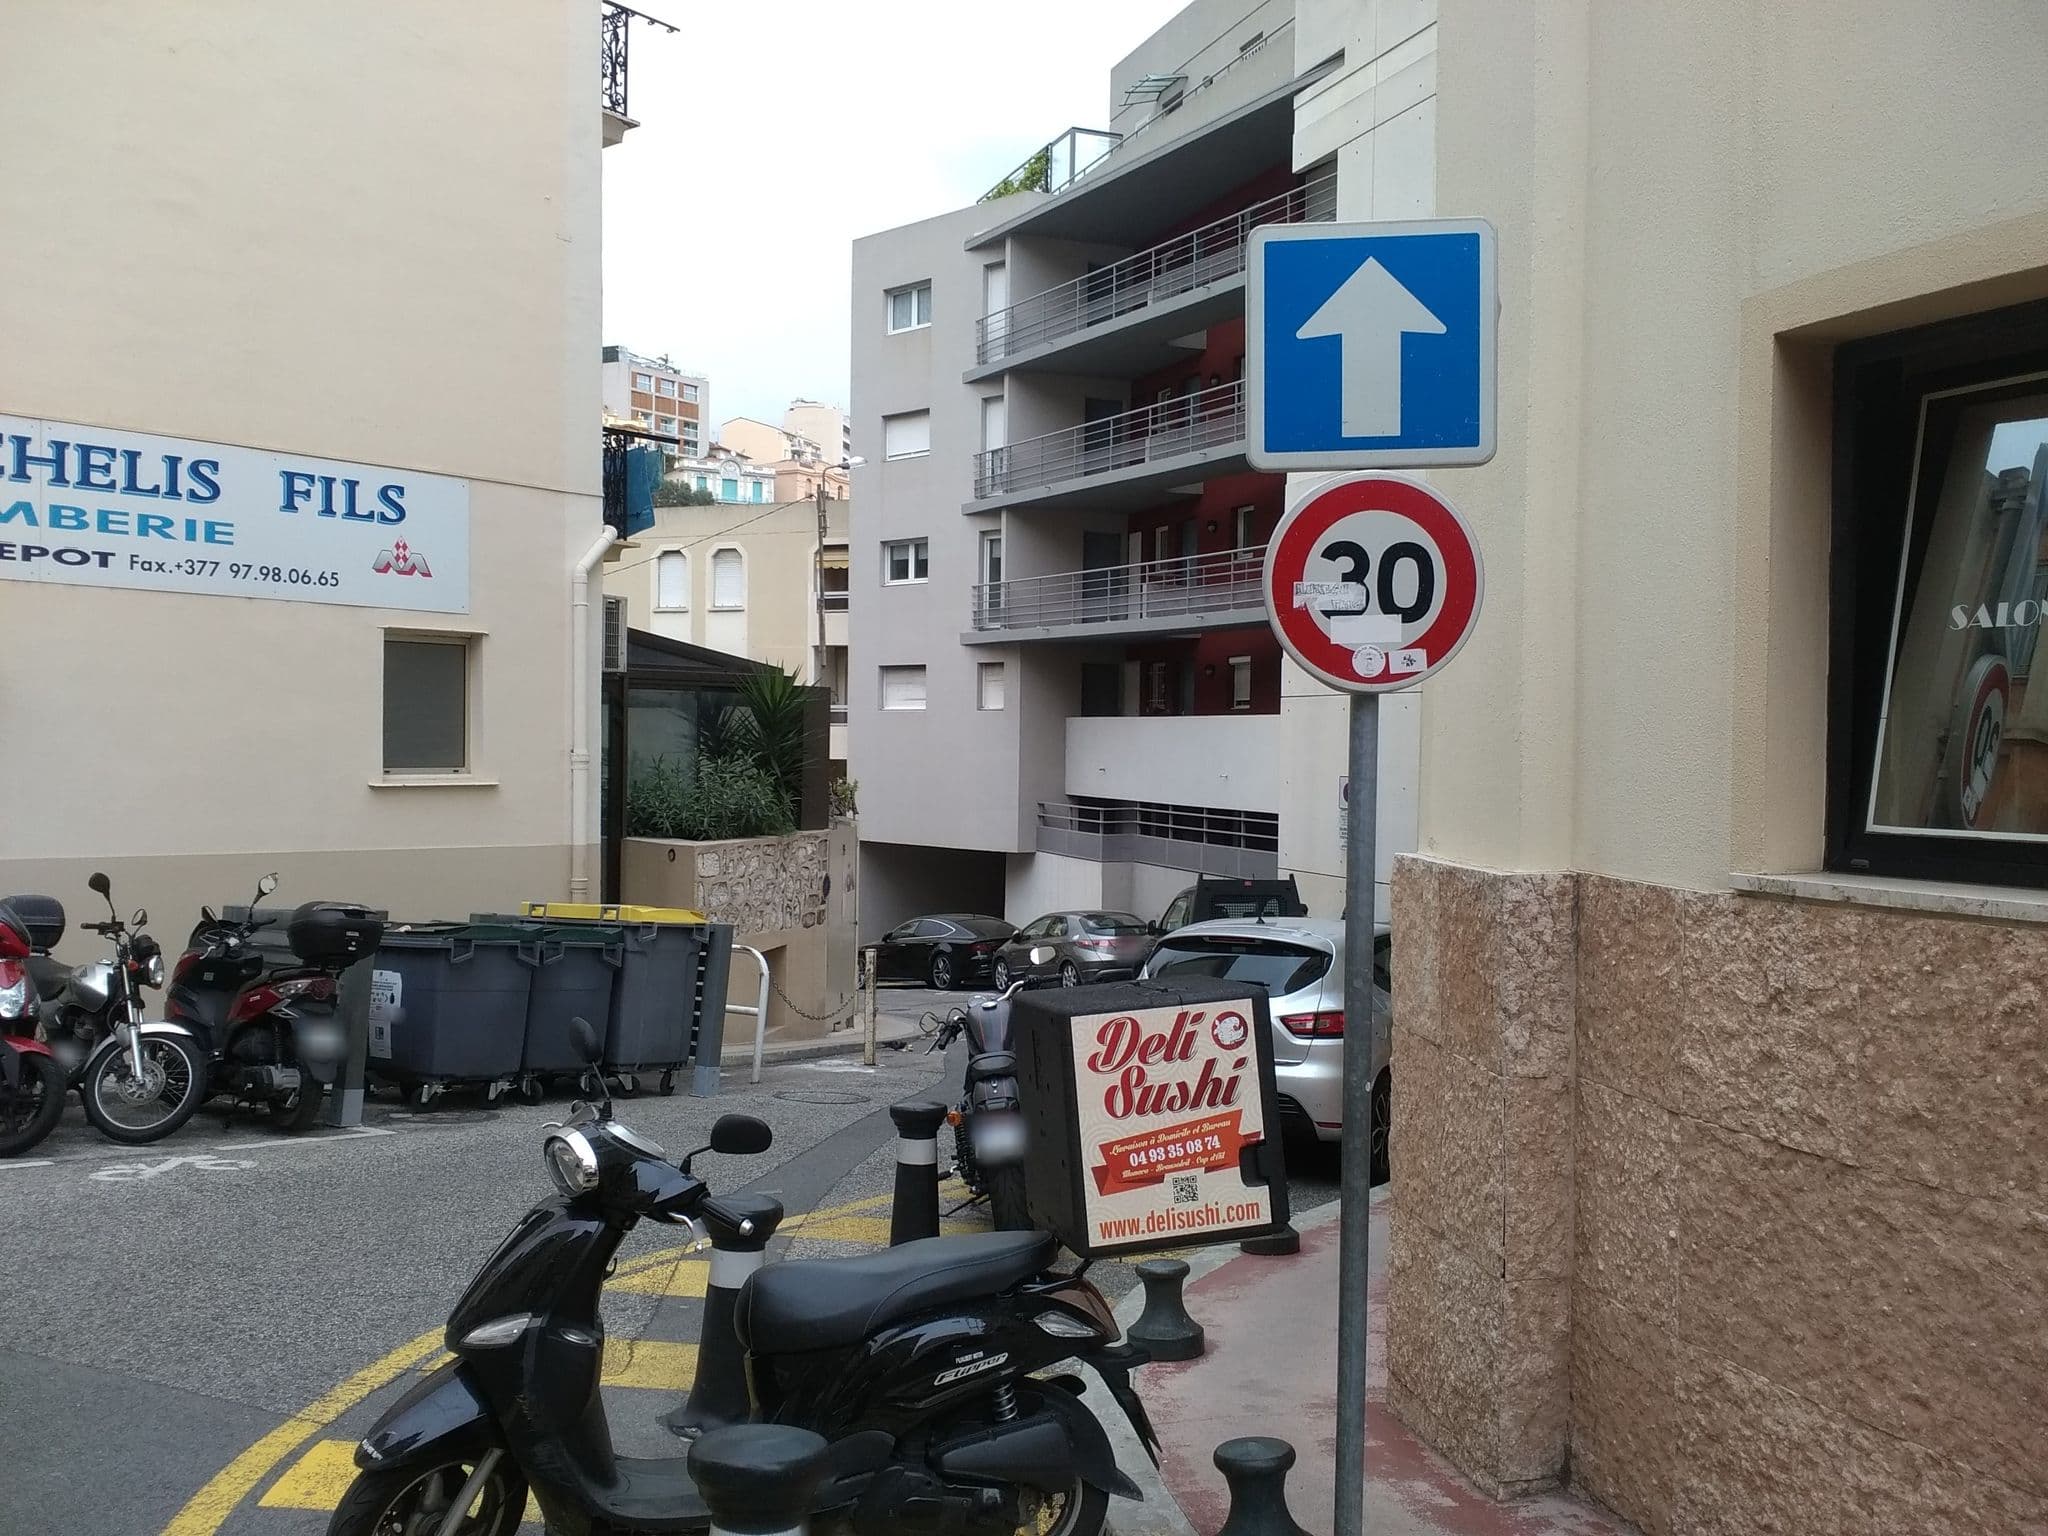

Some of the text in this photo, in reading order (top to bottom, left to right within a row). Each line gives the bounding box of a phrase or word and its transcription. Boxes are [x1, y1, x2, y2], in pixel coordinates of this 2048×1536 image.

[0, 433, 406, 525] HELIS FILS
[229, 563, 339, 587] 97.98.06.65
[1320, 541, 1435, 623] 30
[1087, 1011, 1206, 1073] Deli
[1104, 1056, 1248, 1120] Sushi
[1129, 1135, 1221, 1167] 04 93 35 08 74
[1100, 1201, 1260, 1239] www.delisushi.com
